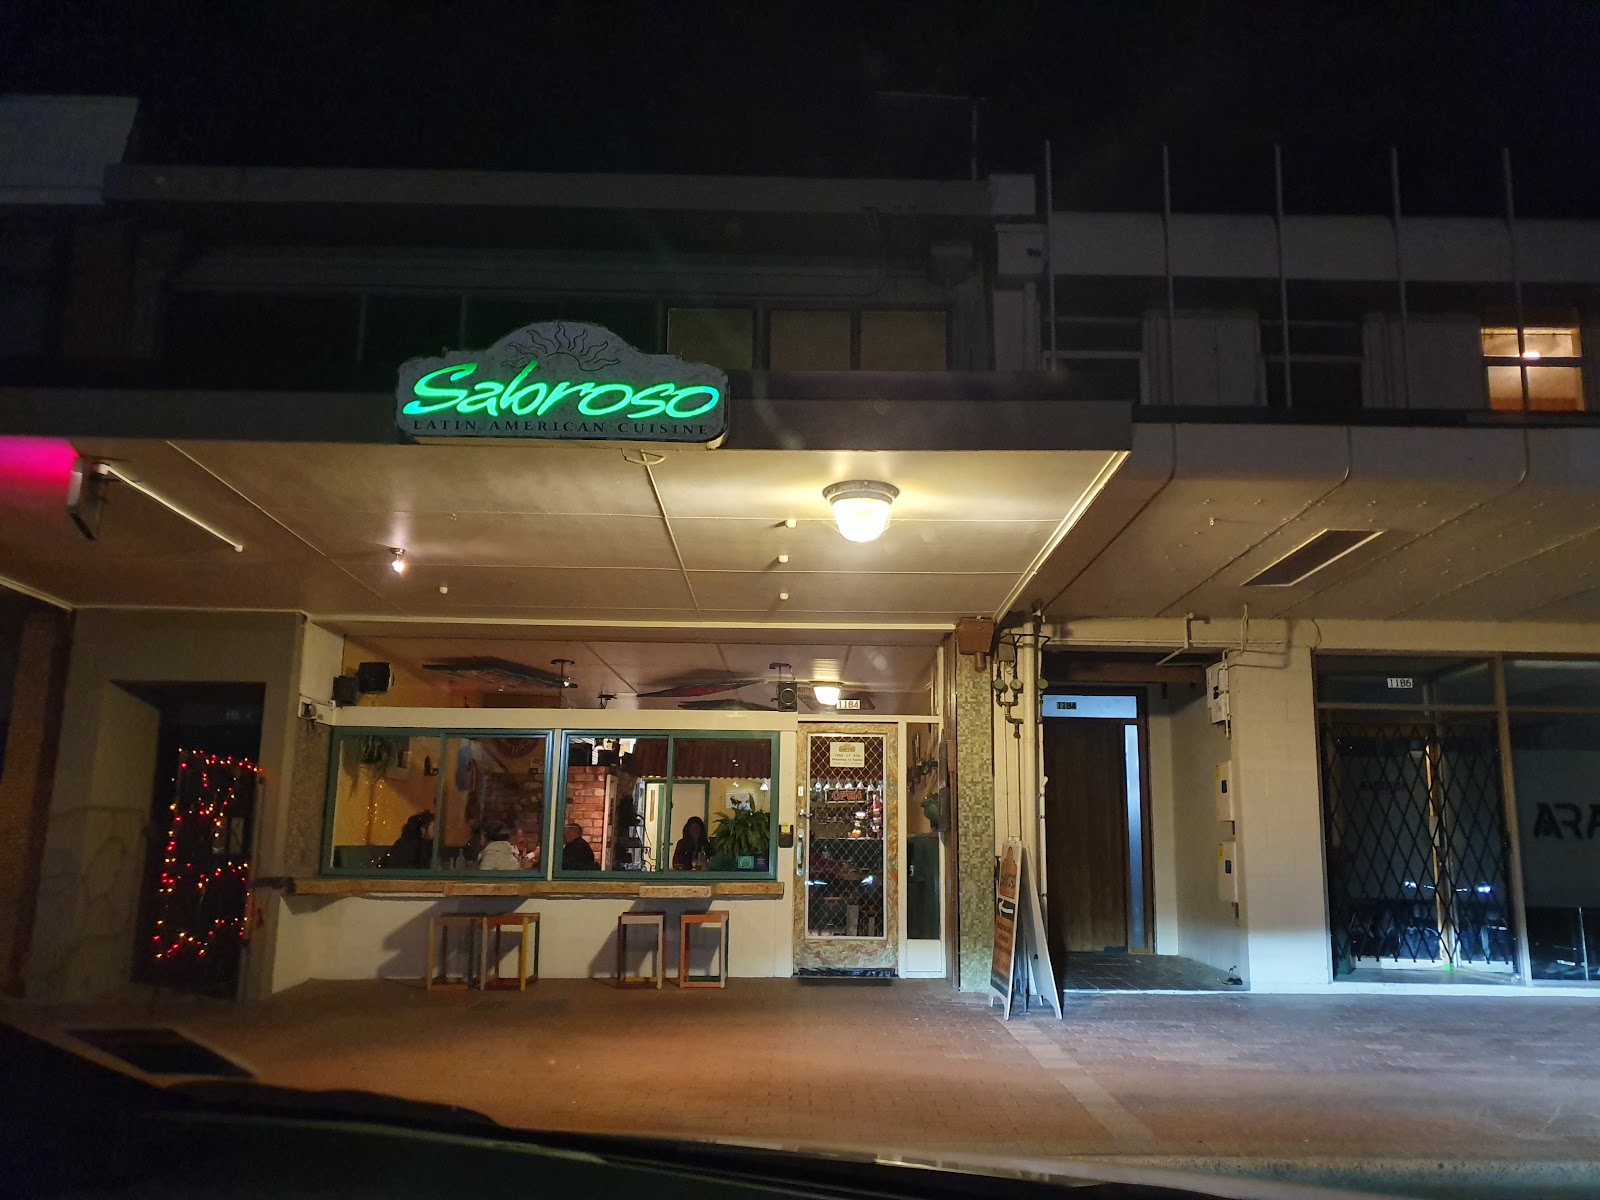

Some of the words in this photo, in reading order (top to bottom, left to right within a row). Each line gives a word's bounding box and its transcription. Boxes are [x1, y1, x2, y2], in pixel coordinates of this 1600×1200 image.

[403, 360, 720, 419] Sabroso
[413, 420, 477, 430] LATIN
[490, 421, 605, 432] AMERICAN
[618, 422, 708, 435] CUISINE
[1389, 679, 1411, 688] 1186
[838, 700, 859, 709] 1184
